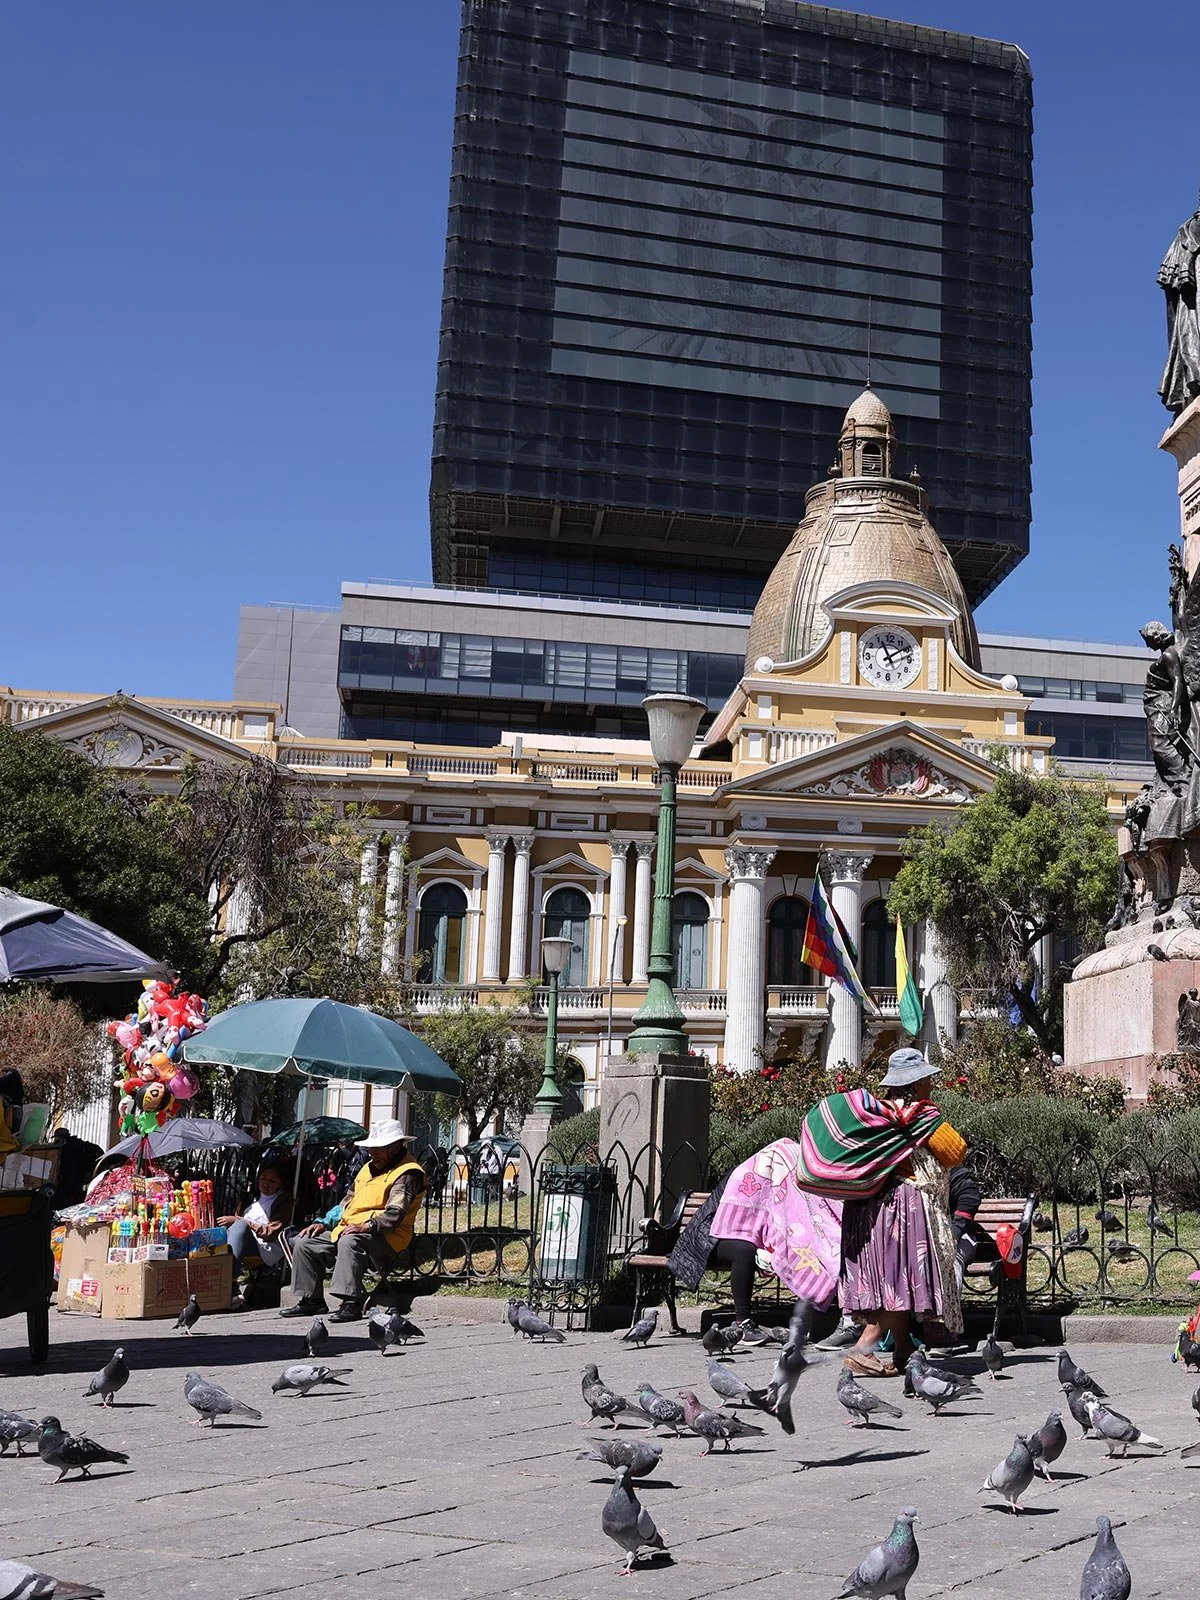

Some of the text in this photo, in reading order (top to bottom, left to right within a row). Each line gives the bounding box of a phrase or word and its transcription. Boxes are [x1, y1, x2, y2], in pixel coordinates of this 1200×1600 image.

[885, 634, 895, 643] 12
[865, 652, 871, 660] 3
[907, 655, 912, 664] 9
[885, 672, 891, 681] 6
